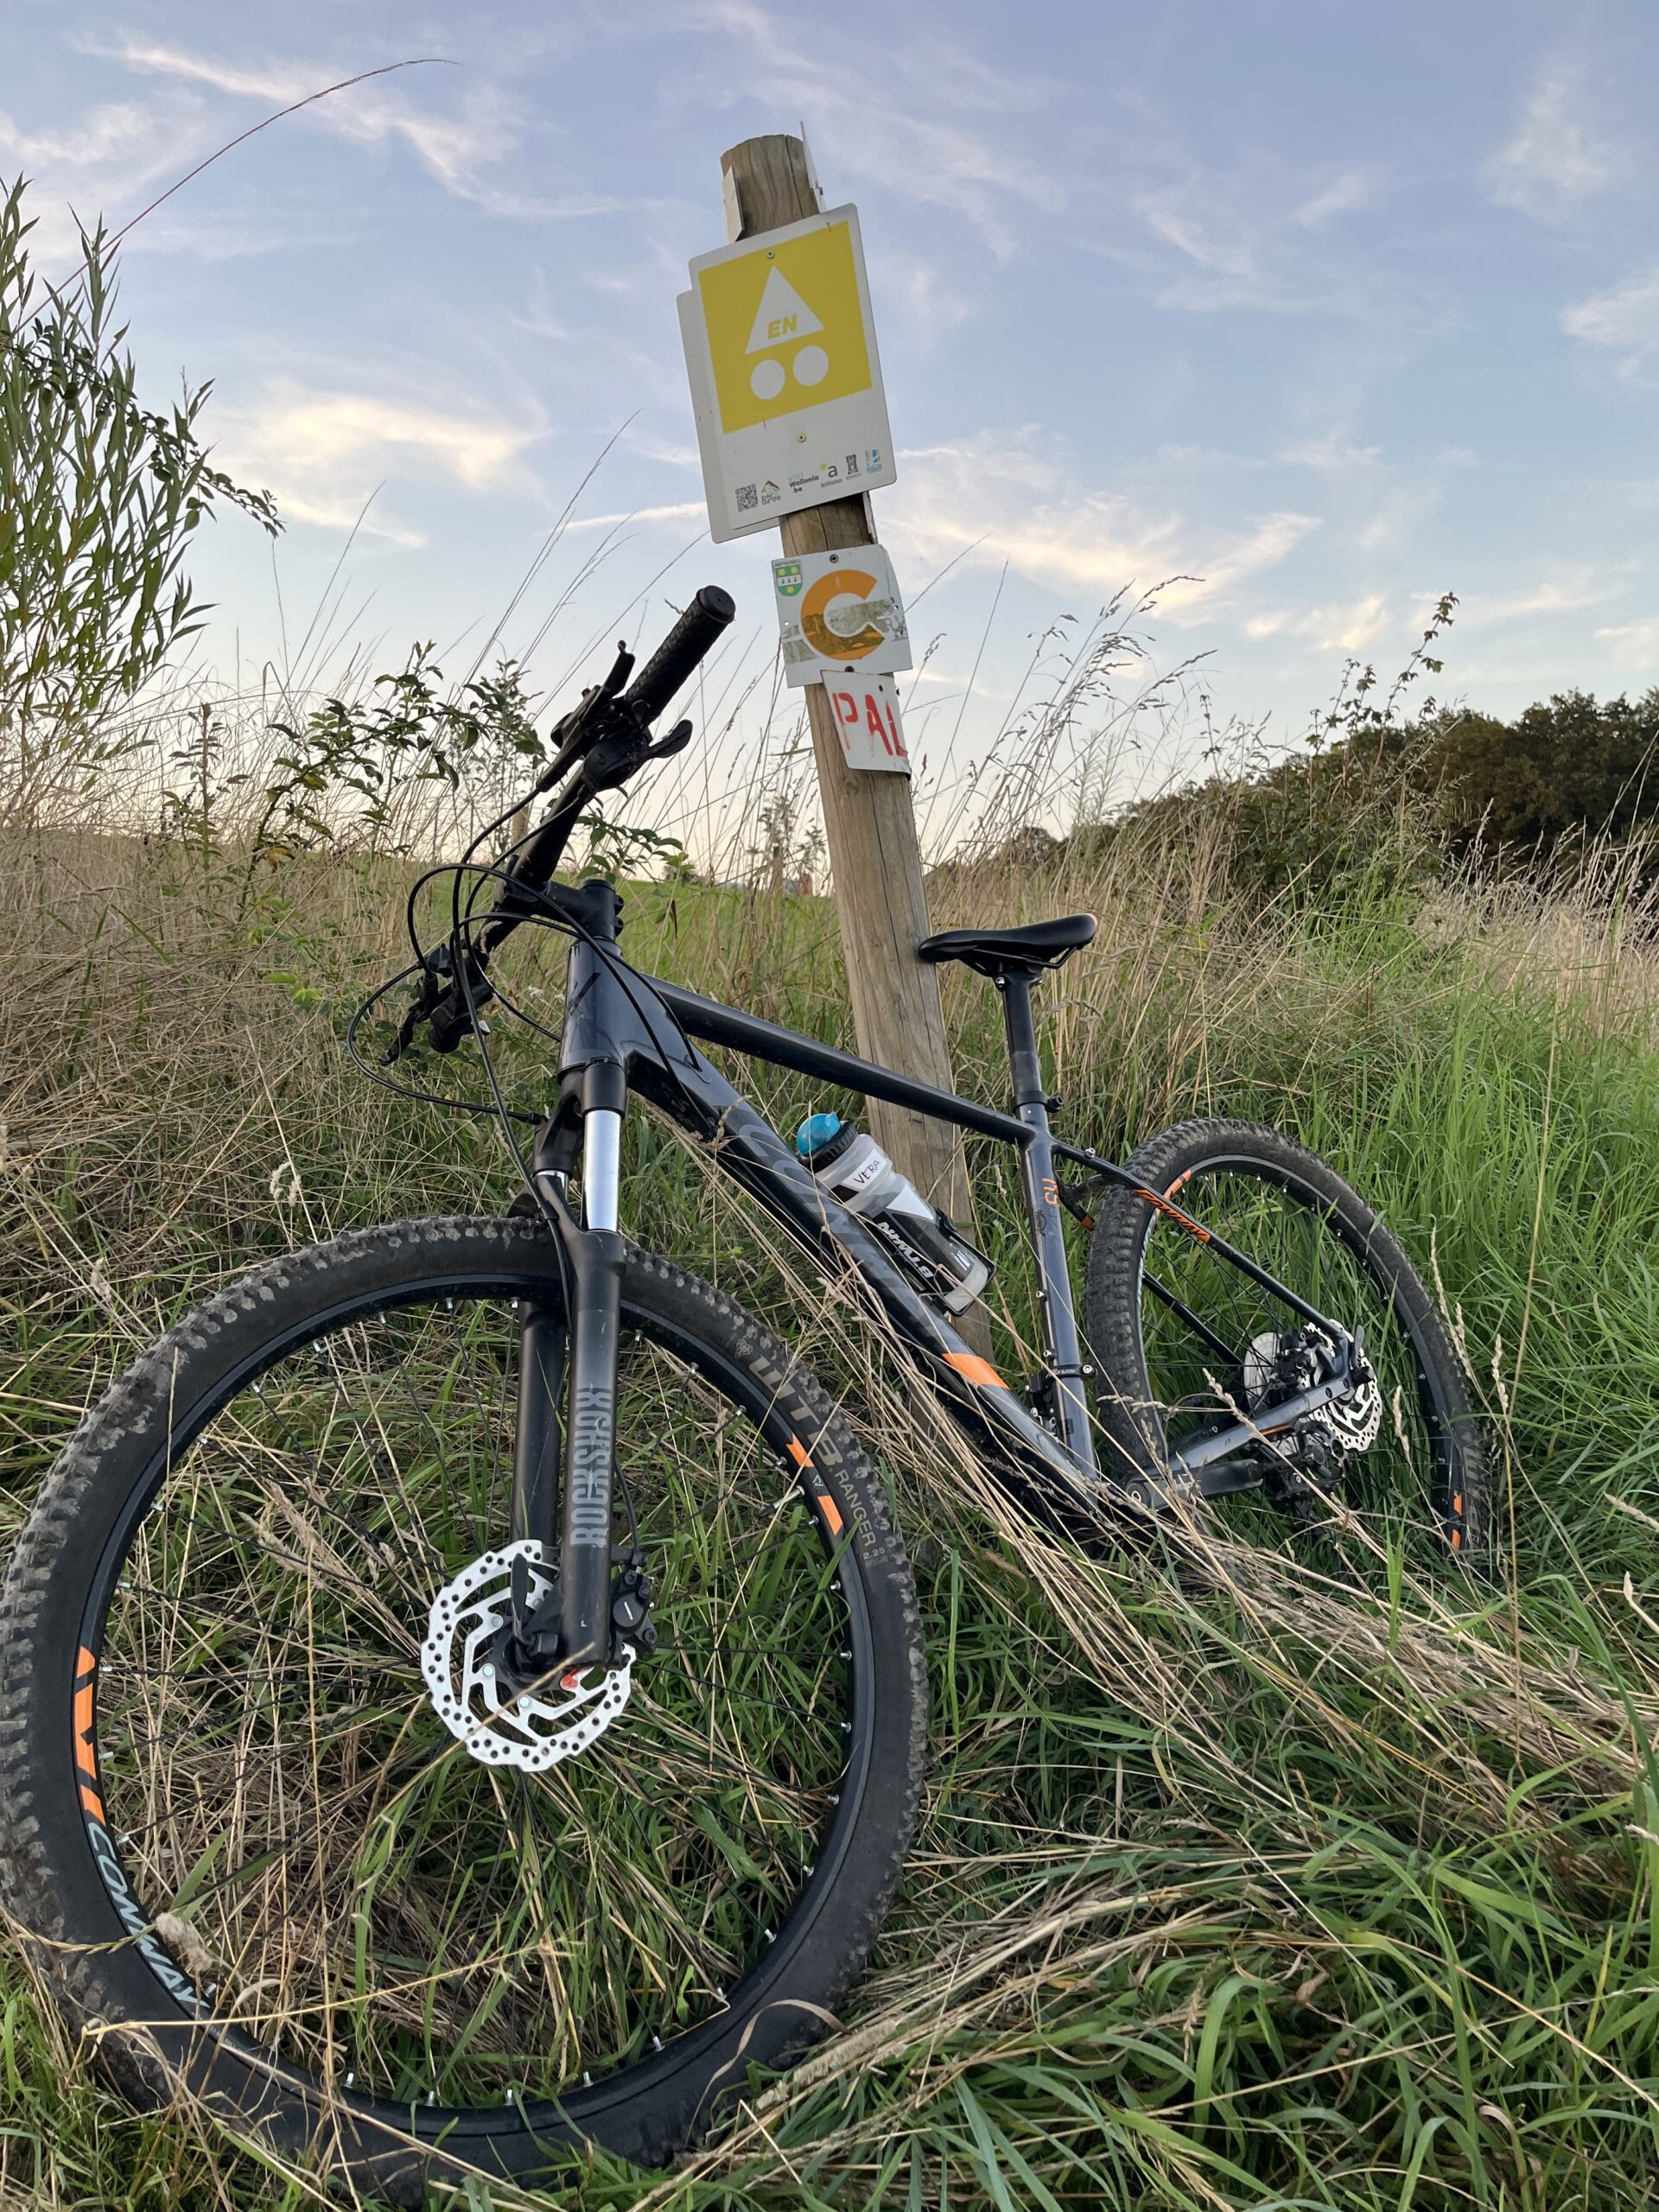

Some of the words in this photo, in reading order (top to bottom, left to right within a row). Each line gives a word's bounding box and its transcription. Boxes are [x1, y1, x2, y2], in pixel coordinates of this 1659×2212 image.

[767, 314, 798, 340] EN
[789, 474, 819, 488] Wallonia
[800, 569, 885, 661] C
[832, 692, 908, 757] PAL
[853, 1160, 880, 1184] VERA
[748, 1355, 843, 1466] WTB
[570, 1390, 612, 1548] ROCKSHOX
[835, 1469, 876, 1547] RANGER
[862, 1547, 886, 1560] 2.25
[88, 1822, 210, 2008] CONWAY
